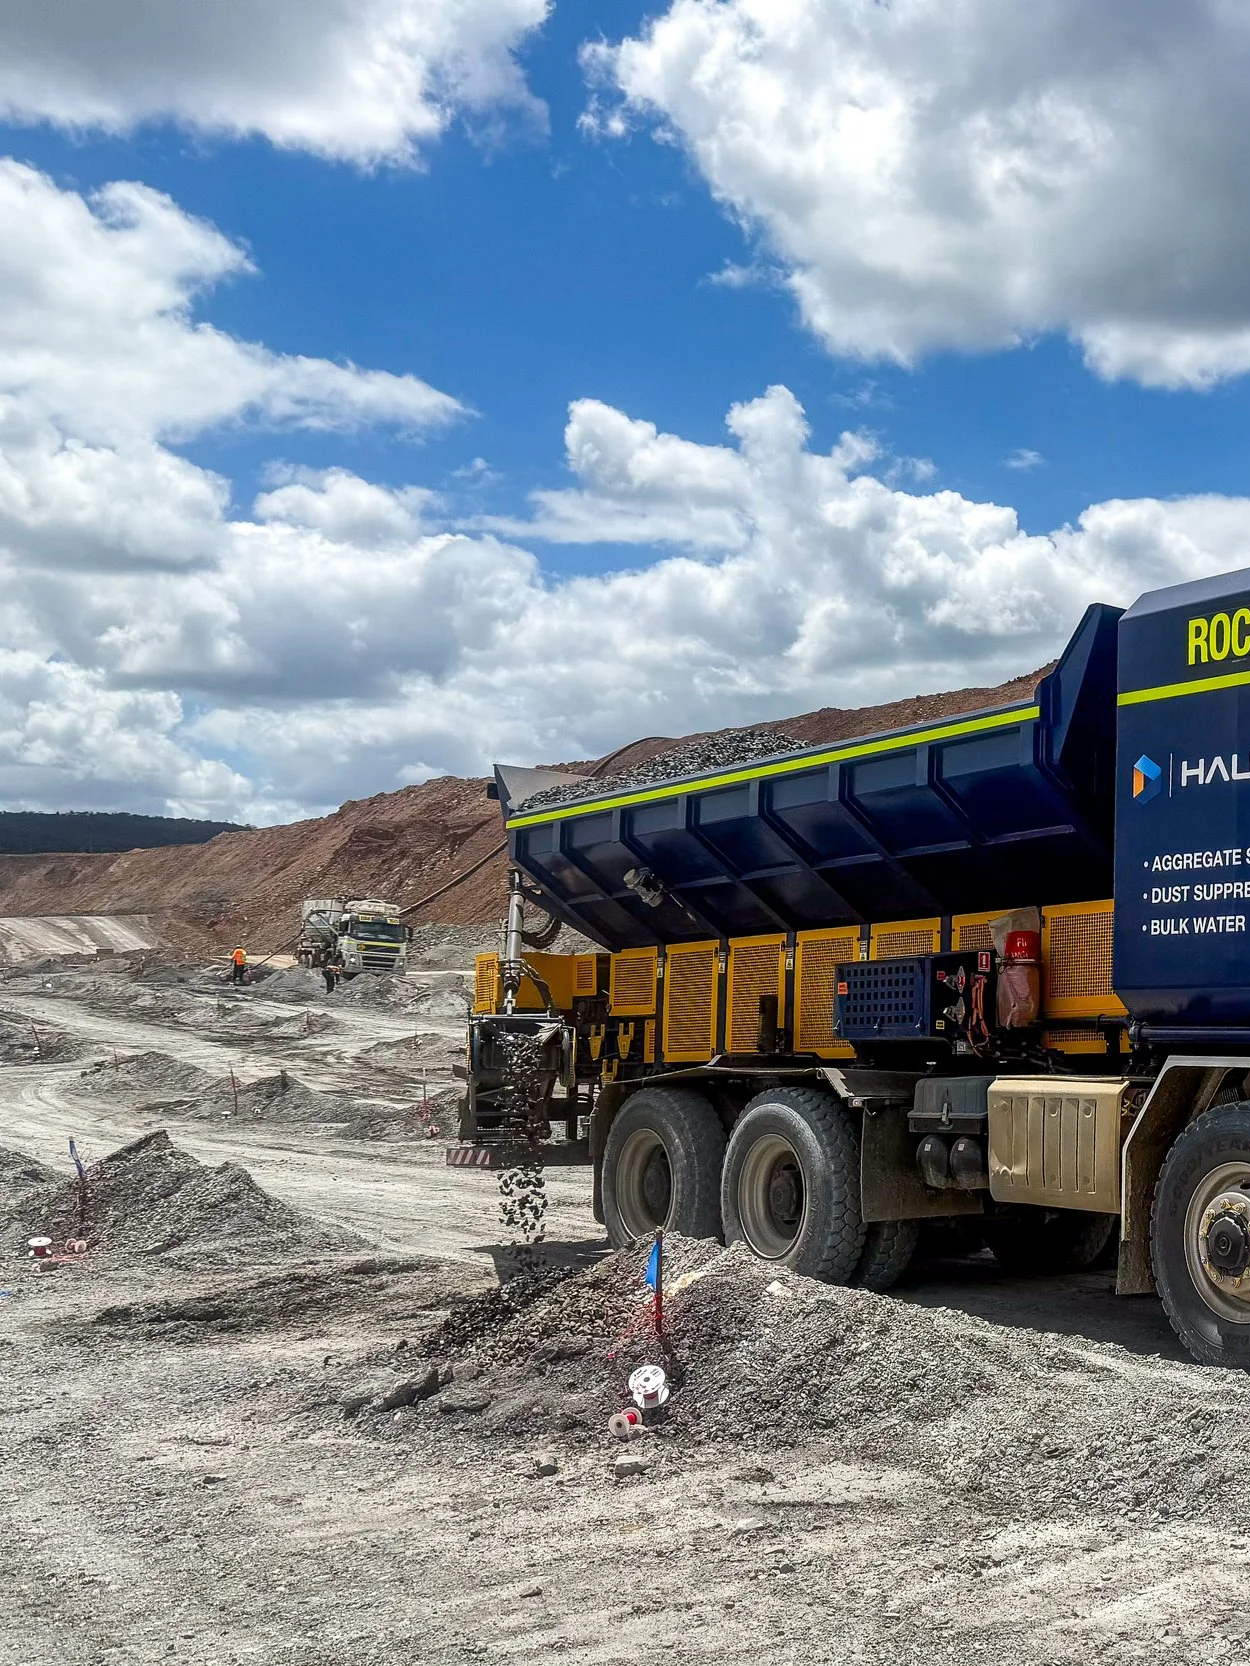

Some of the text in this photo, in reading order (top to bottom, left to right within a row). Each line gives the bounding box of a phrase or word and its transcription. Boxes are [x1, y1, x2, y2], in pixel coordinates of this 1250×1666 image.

[1151, 848, 1242, 872] AGGREGATE
[1151, 885, 1191, 904] DUST
[1150, 915, 1246, 936] BULK WATER
